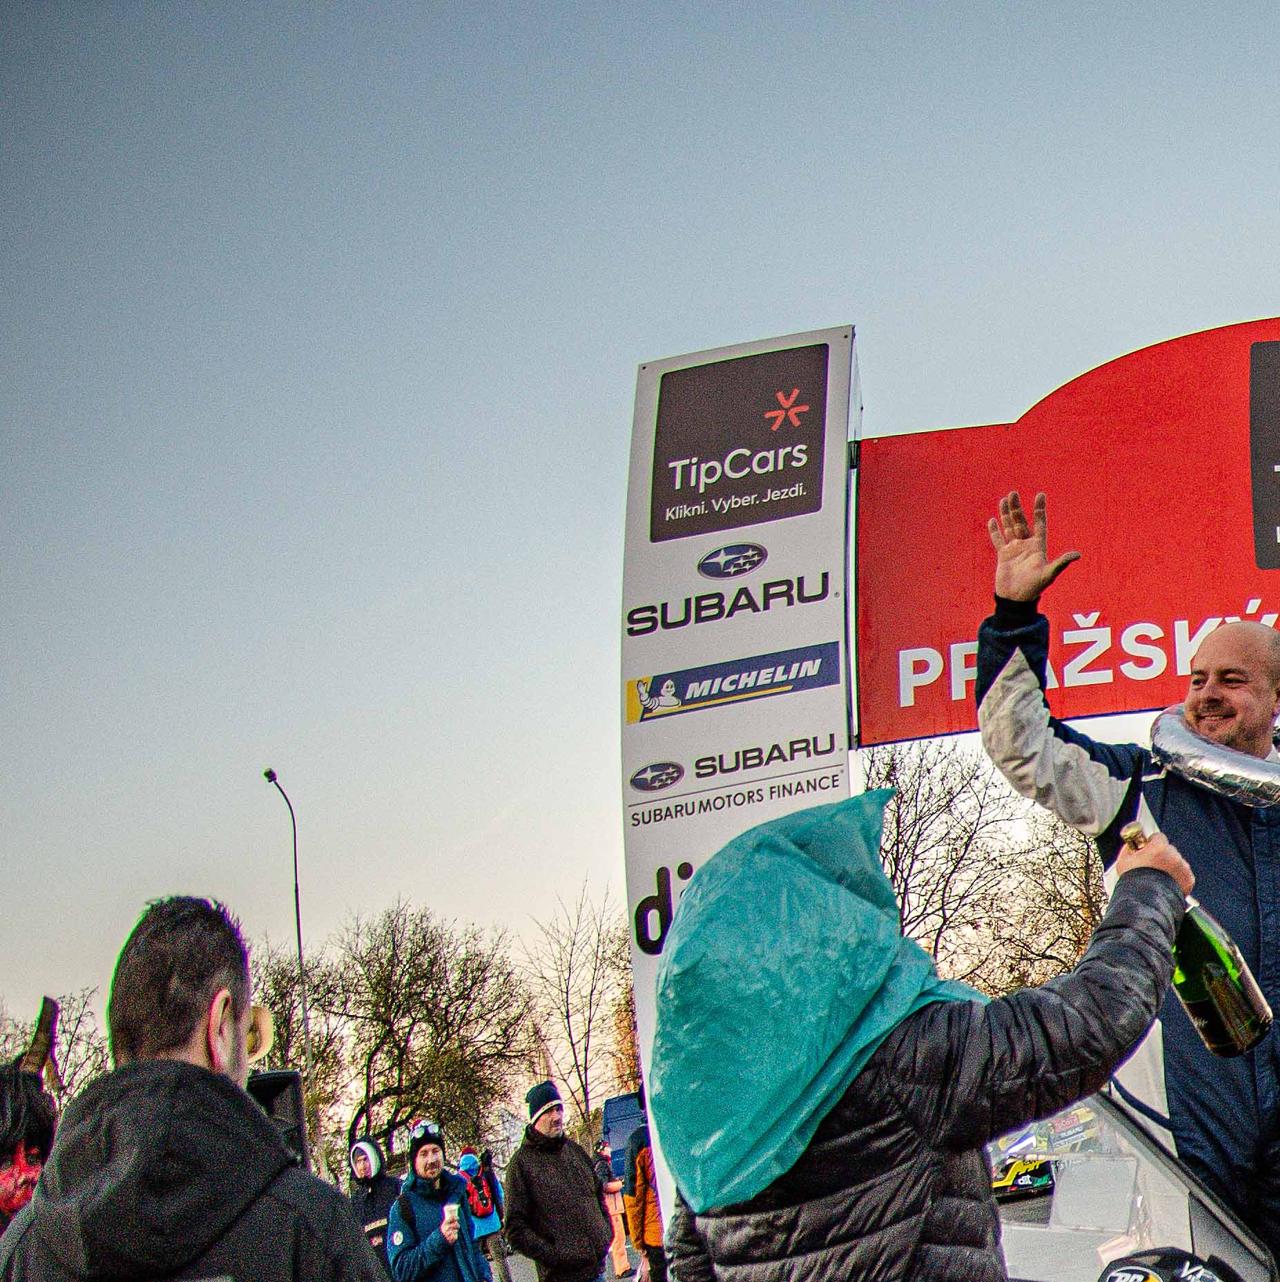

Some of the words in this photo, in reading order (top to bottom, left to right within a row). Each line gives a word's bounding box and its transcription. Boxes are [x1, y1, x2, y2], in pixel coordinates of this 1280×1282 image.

[667, 442, 809, 494] TipCars
[664, 499, 709, 522] Klikni.
[711, 490, 760, 515] Vyber.
[762, 482, 808, 504] Jezdi.
[626, 572, 831, 638] SUBARU
[684, 658, 823, 702] MICHELIN
[694, 732, 838, 779] SUBARU
[630, 800, 697, 828] SUBARU
[697, 786, 765, 816] MOTORS
[768, 772, 842, 801] FINANCE
